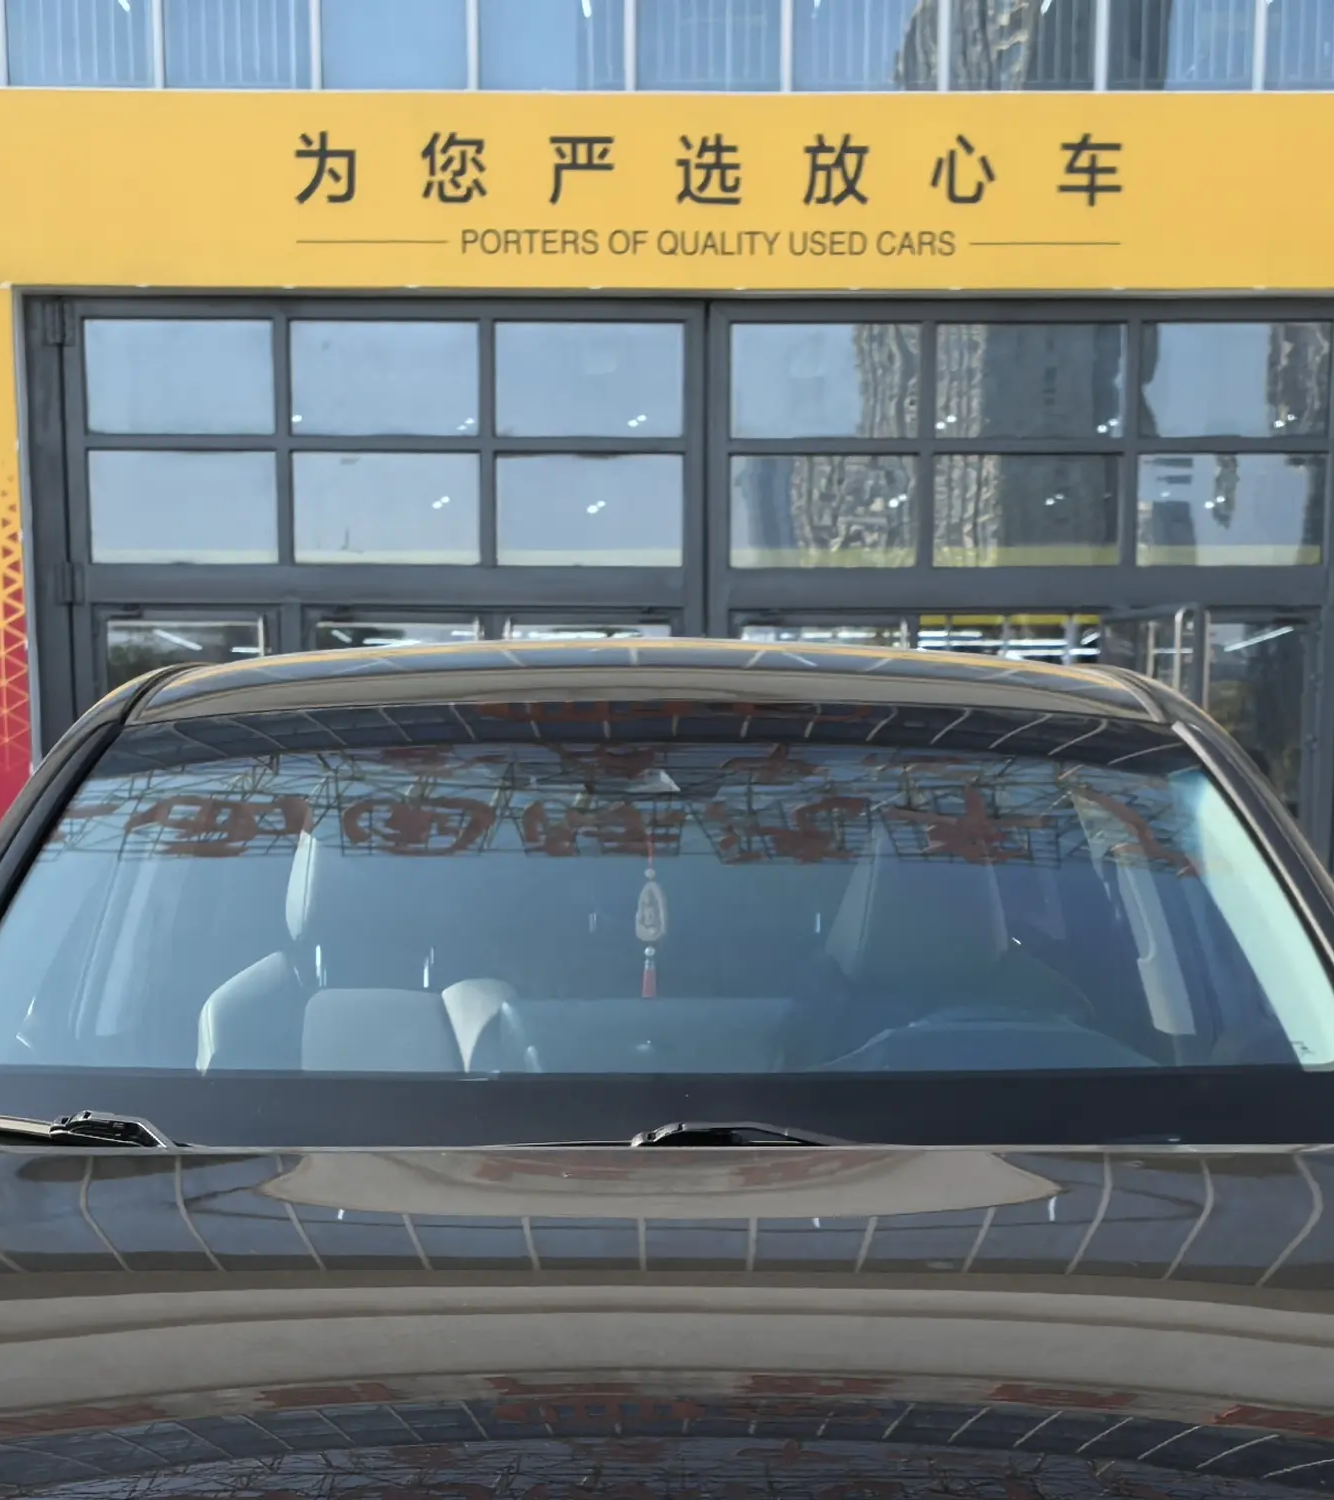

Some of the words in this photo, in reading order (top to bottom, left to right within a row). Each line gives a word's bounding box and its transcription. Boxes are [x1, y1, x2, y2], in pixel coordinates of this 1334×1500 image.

[294, 131, 1122, 207] 为您严选放心车
[460, 228, 599, 256] PORTERS
[607, 230, 649, 256] OF
[656, 230, 781, 257] QUALITY
[788, 231, 868, 257] USED
[875, 231, 957, 257] CARS
